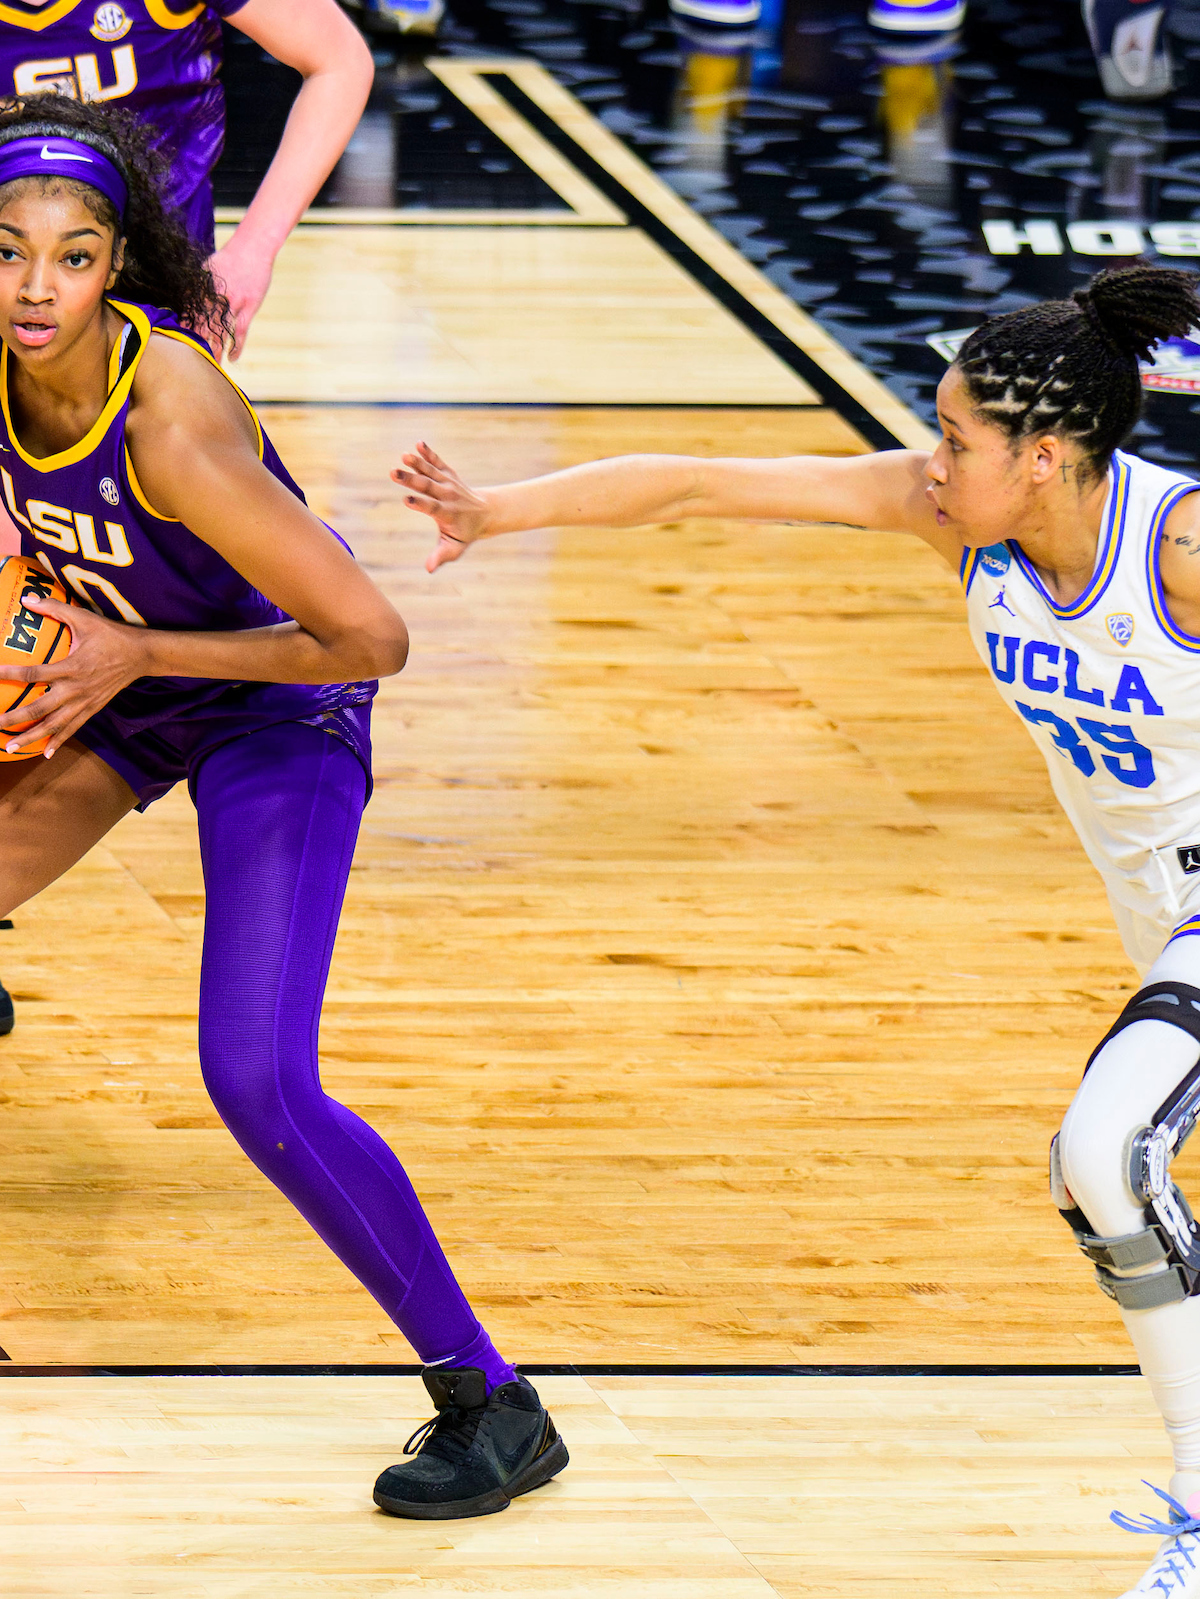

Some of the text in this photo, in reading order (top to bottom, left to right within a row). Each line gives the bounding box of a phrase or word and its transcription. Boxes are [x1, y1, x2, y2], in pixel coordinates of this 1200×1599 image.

[100, 479, 119, 504] SEC
[0, 465, 135, 567] LSU
[1108, 615, 1133, 634] PAC
[1115, 627, 1131, 641] 12
[985, 632, 1165, 716] UCLA
